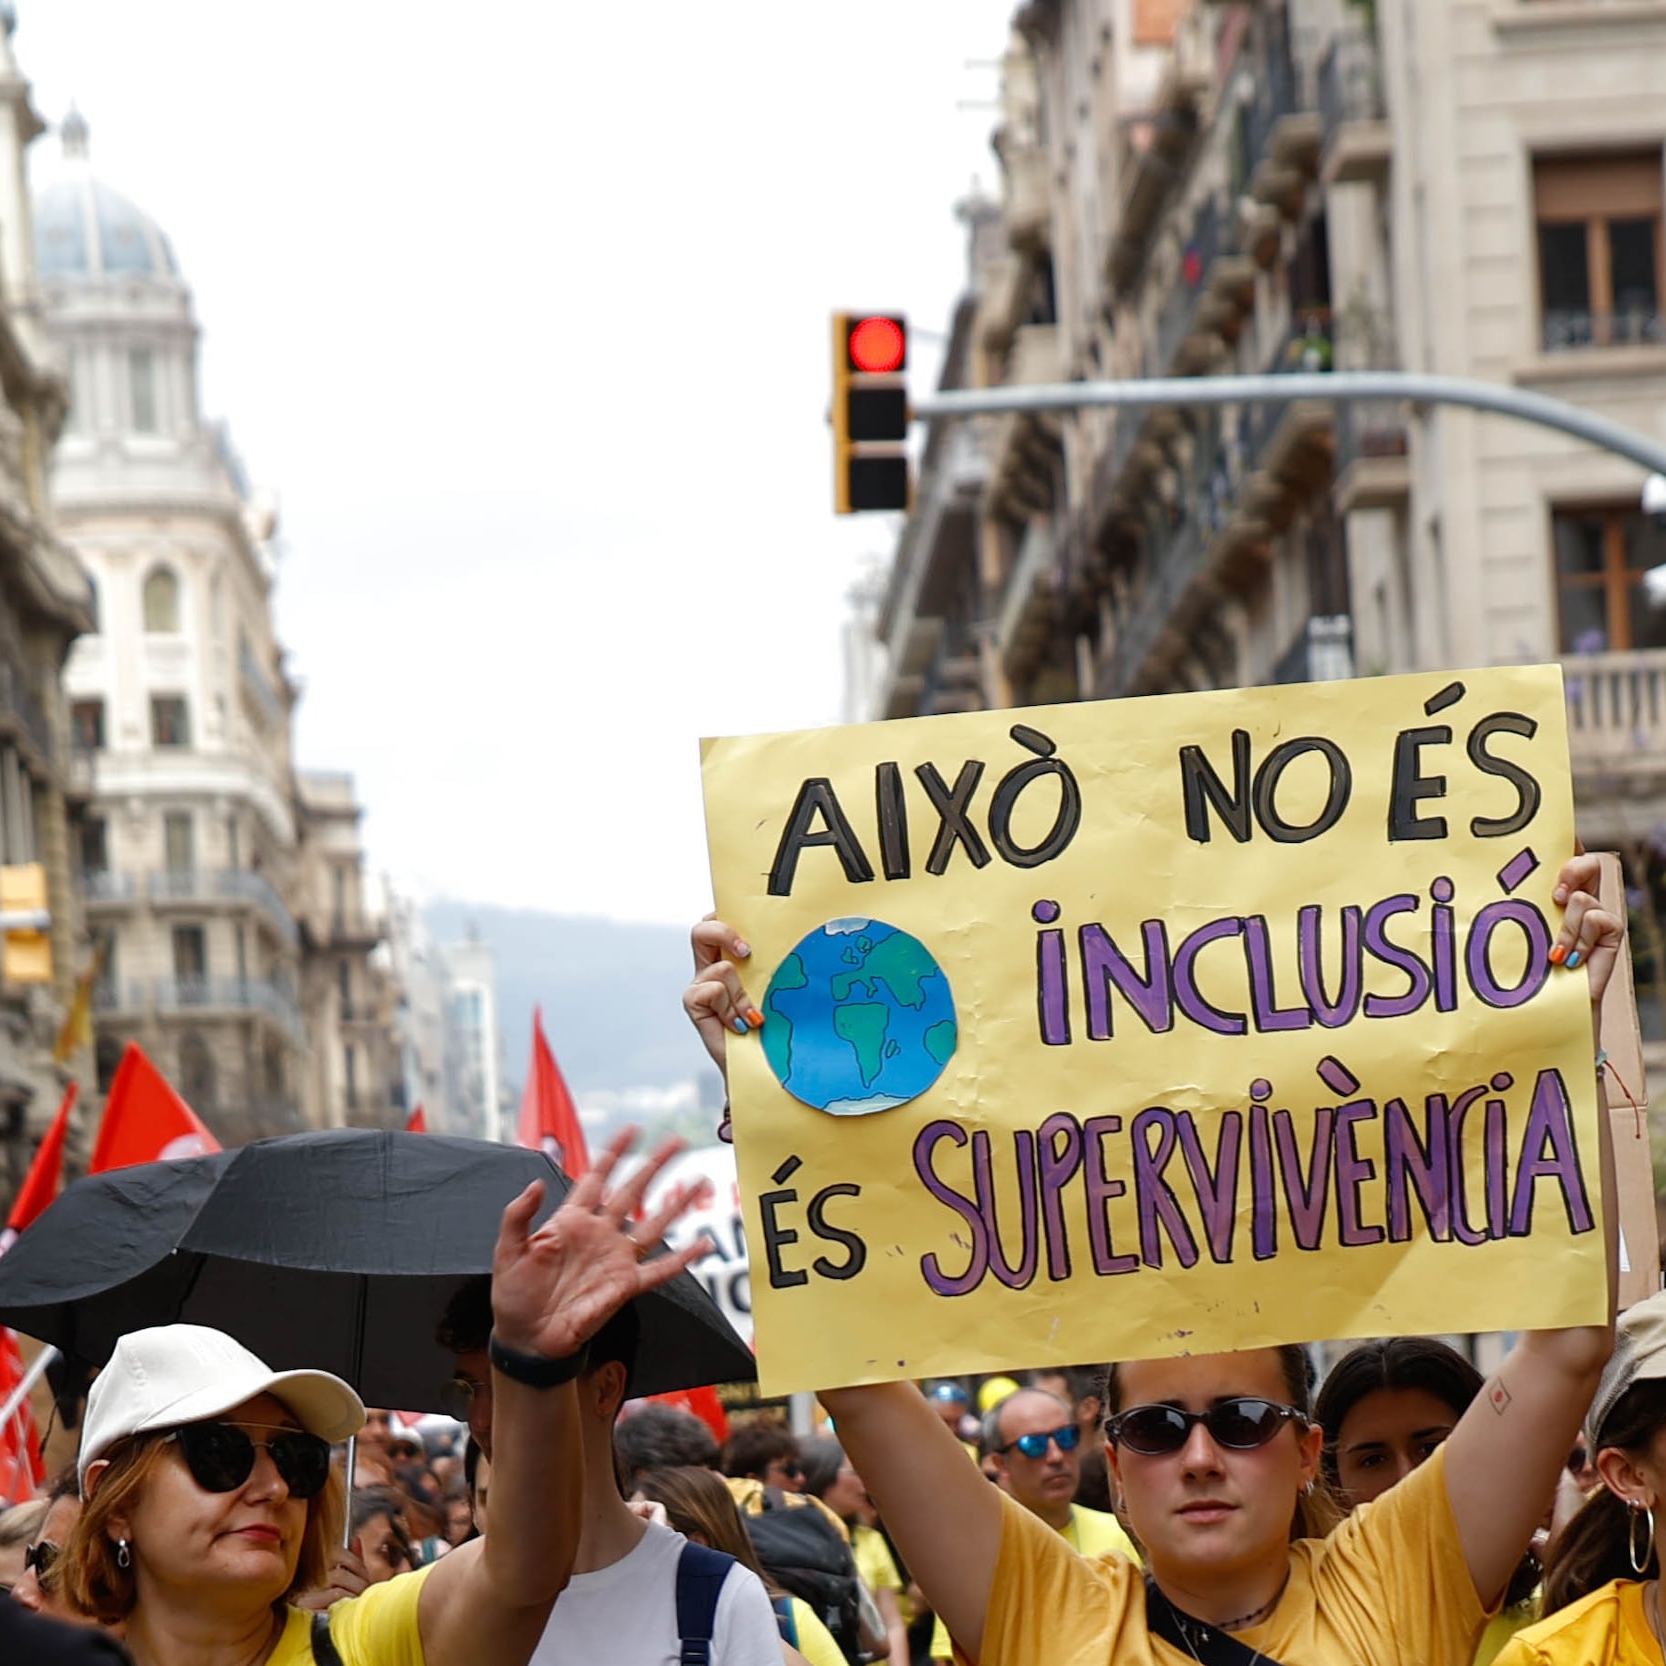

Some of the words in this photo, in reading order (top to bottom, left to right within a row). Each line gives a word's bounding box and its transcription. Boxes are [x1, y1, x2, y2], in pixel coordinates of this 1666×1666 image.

[768, 725, 1082, 897] AIXÒ
[1180, 728, 1352, 845] NO
[1387, 681, 1541, 842] ÉS
[759, 1156, 866, 1289] ÉS
